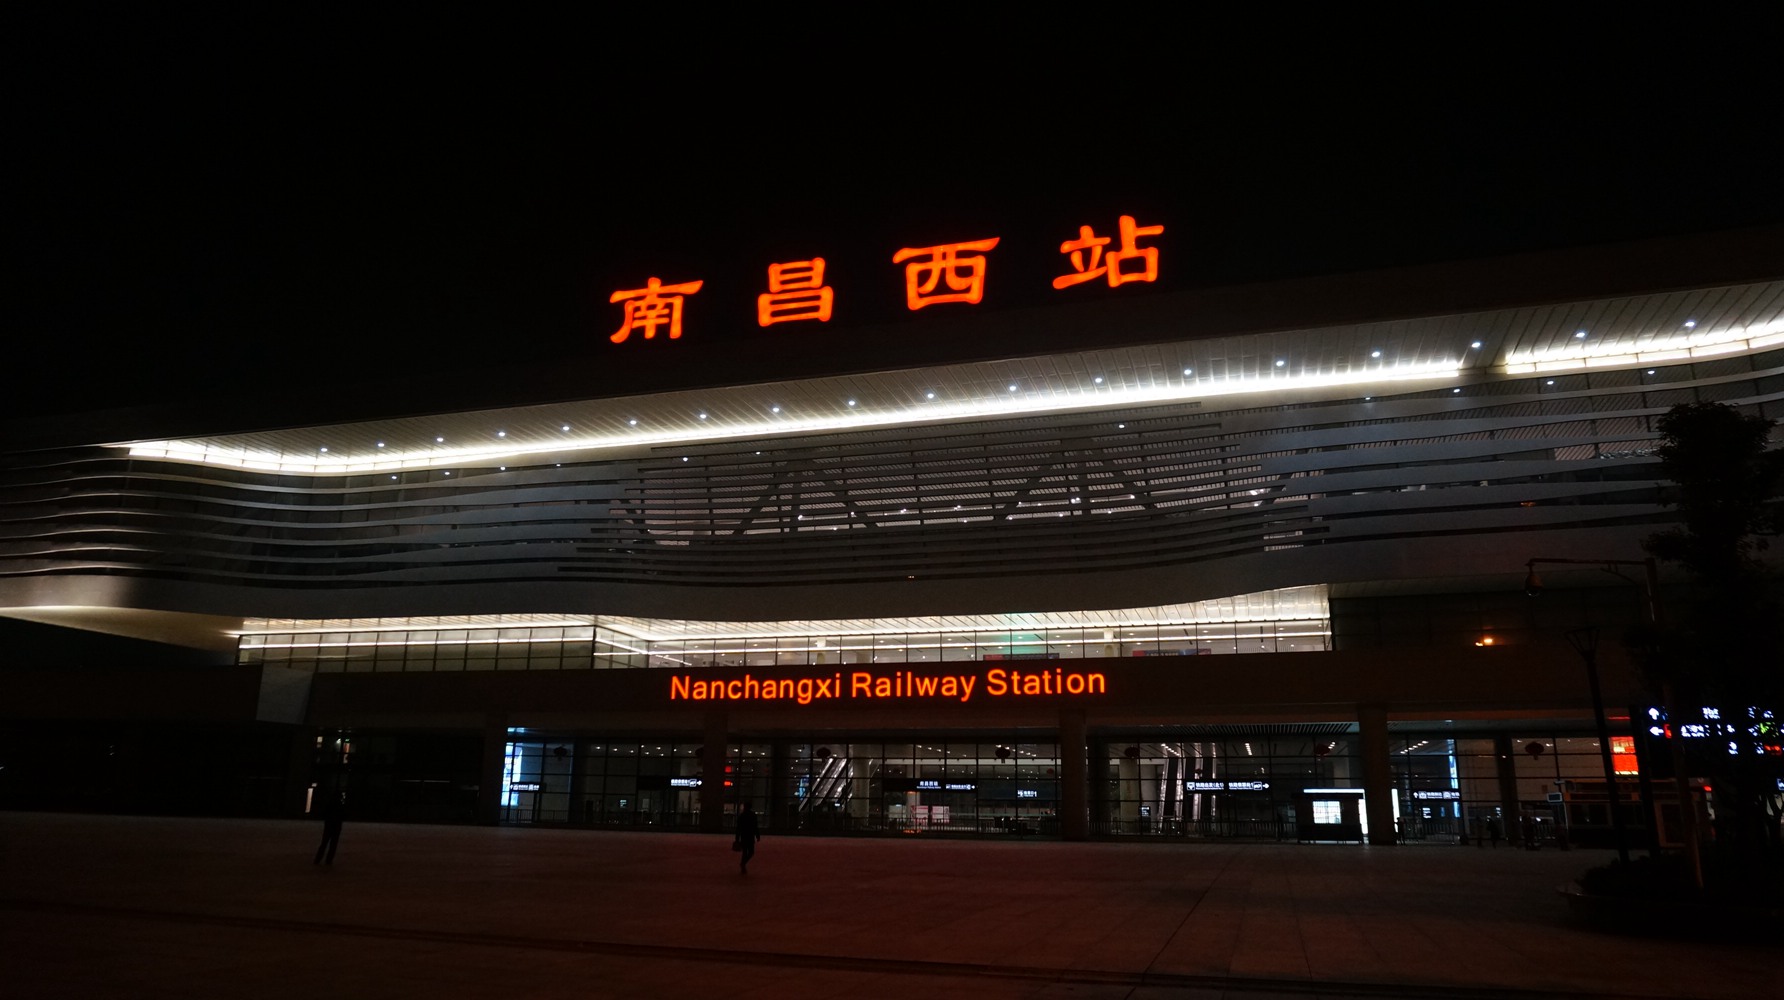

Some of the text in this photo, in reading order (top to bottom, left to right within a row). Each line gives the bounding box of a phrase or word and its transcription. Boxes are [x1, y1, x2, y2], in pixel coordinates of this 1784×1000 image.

[610, 215, 1164, 343] 南昌西站
[670, 668, 1106, 705] Nanchangxi Railway Station
